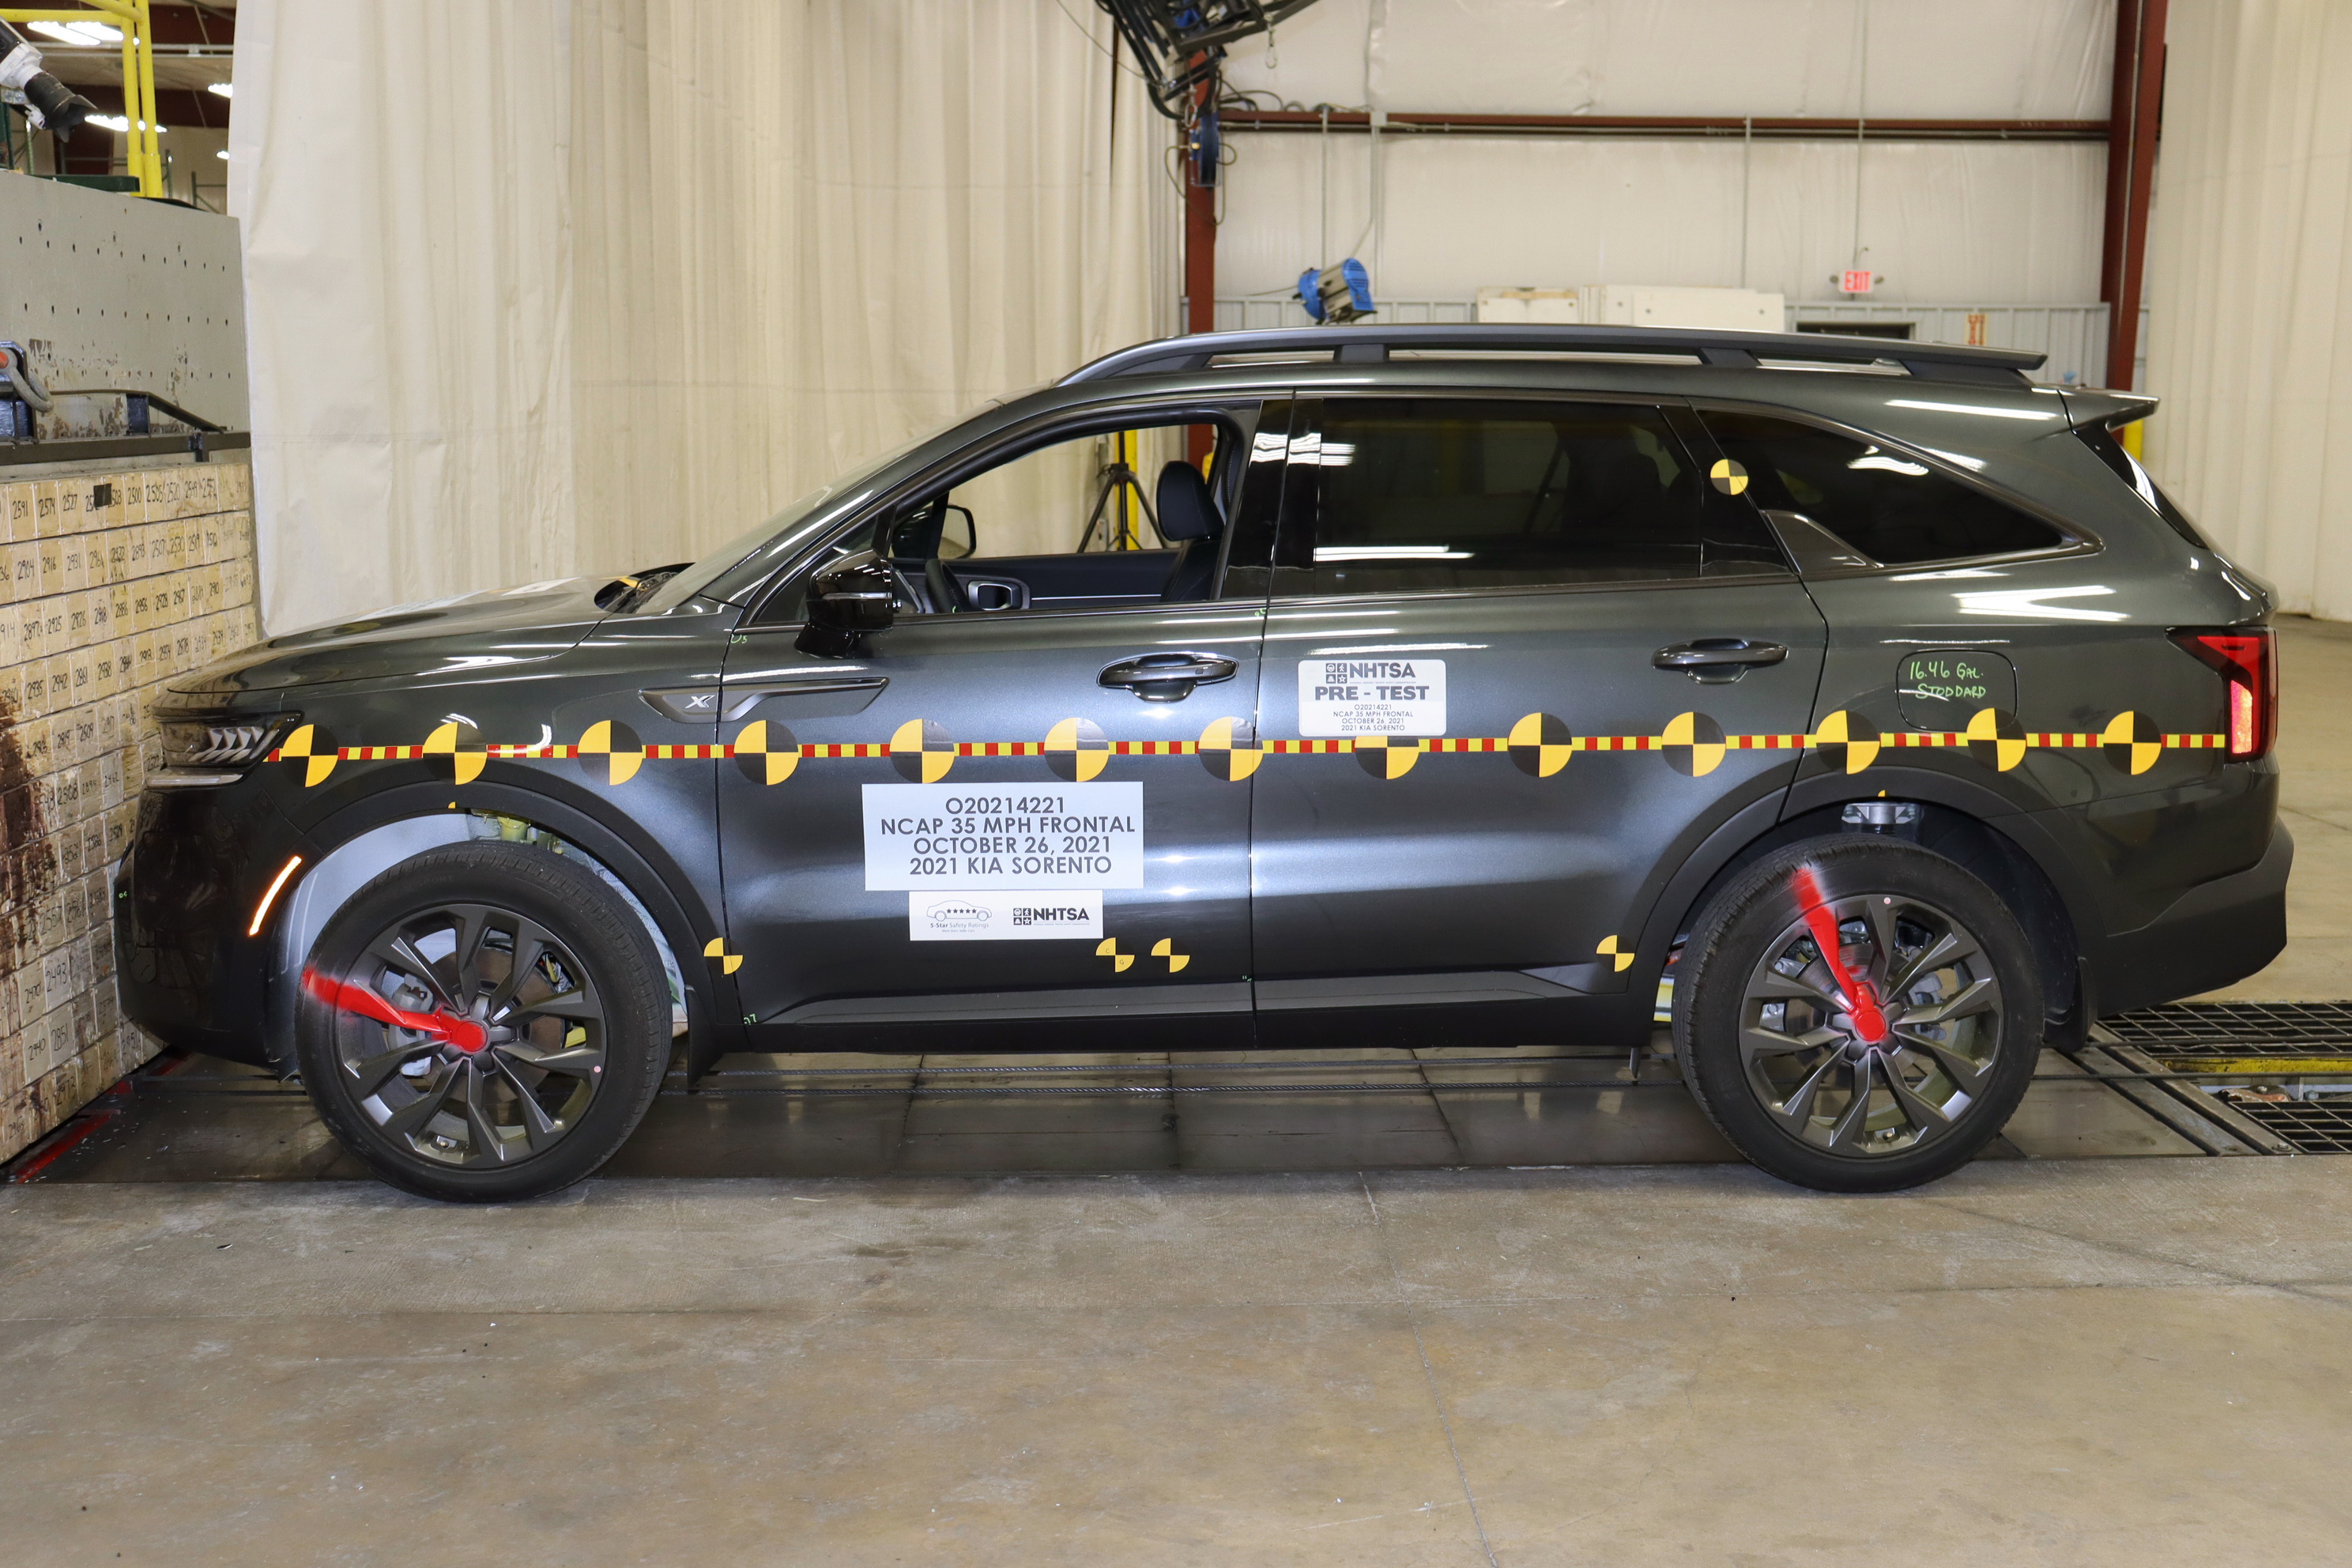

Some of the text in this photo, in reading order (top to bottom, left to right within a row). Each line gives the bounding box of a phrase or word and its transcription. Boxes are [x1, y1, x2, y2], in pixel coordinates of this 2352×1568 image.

[1844, 270, 1871, 292] EXIT
[108, 488, 122, 508] 503
[1349, 662, 1415, 679] NHTSA
[1314, 686, 1359, 701] PRE
[1376, 685, 1430, 701] TEST
[880, 816, 1136, 835] NCAP 35 MPH FRONTAL
[913, 835, 1110, 856] OCTOBER 26, 2021
[910, 855, 1113, 876] 2021 KIA SORENTO
[1033, 907, 1090, 921] NHTSA
[45, 962, 68, 993] 2493
